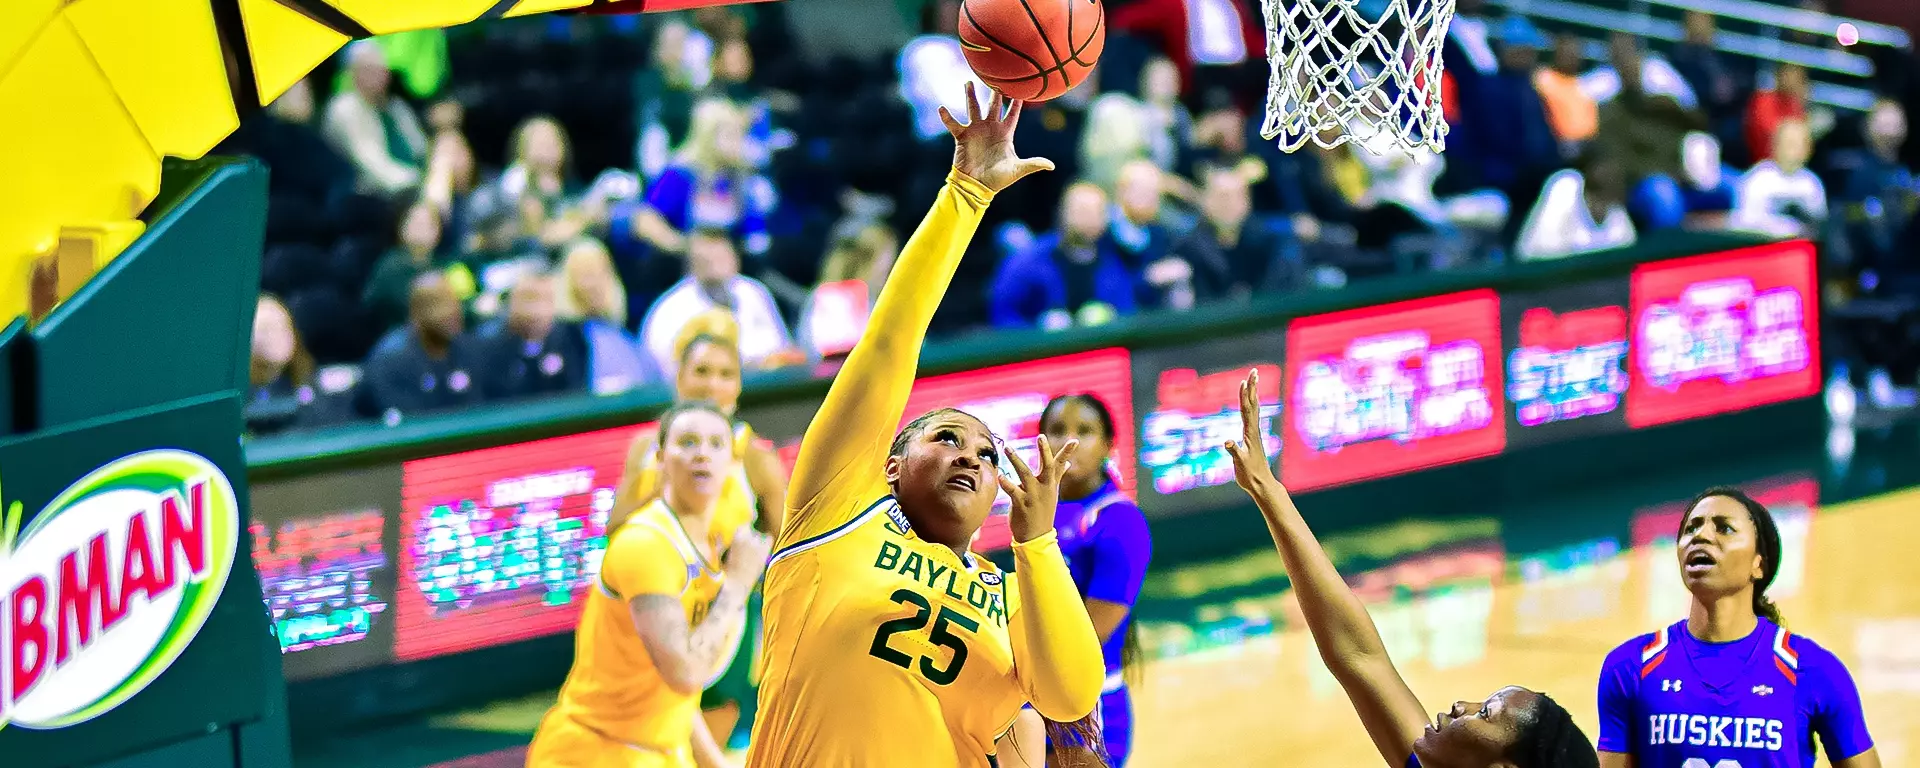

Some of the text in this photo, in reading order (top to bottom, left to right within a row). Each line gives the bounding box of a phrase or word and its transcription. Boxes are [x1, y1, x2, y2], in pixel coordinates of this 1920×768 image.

[0, 482, 206, 704] BMAN
[874, 540, 1002, 628] BAYLOR
[869, 588, 979, 686] 25
[1649, 713, 1783, 751] HUSKIES
